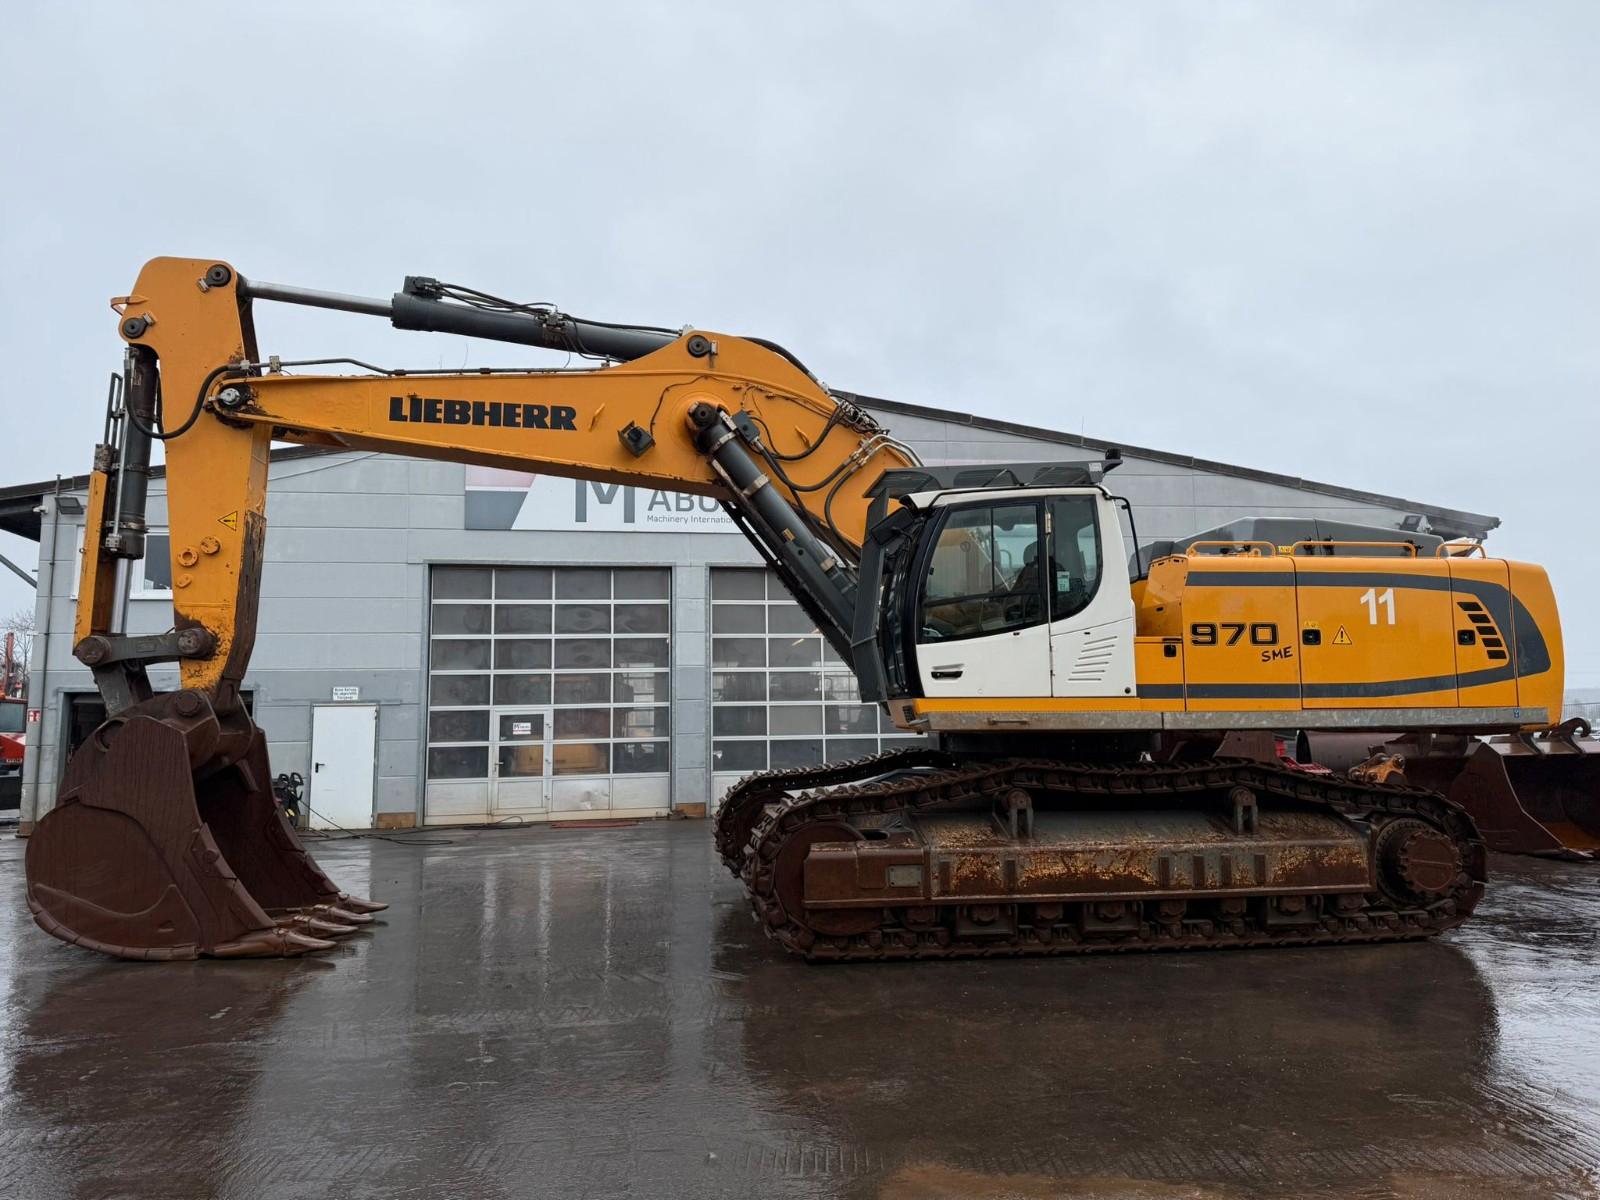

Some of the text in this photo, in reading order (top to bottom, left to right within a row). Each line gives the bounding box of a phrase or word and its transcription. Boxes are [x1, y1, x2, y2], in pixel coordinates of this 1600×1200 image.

[389, 397, 577, 430] LIEBHERR
[575, 479, 636, 523] M
[647, 515, 688, 525] Machinery
[1360, 588, 1396, 625] 11
[1190, 622, 1279, 647] 970
[1261, 646, 1293, 662] SME
